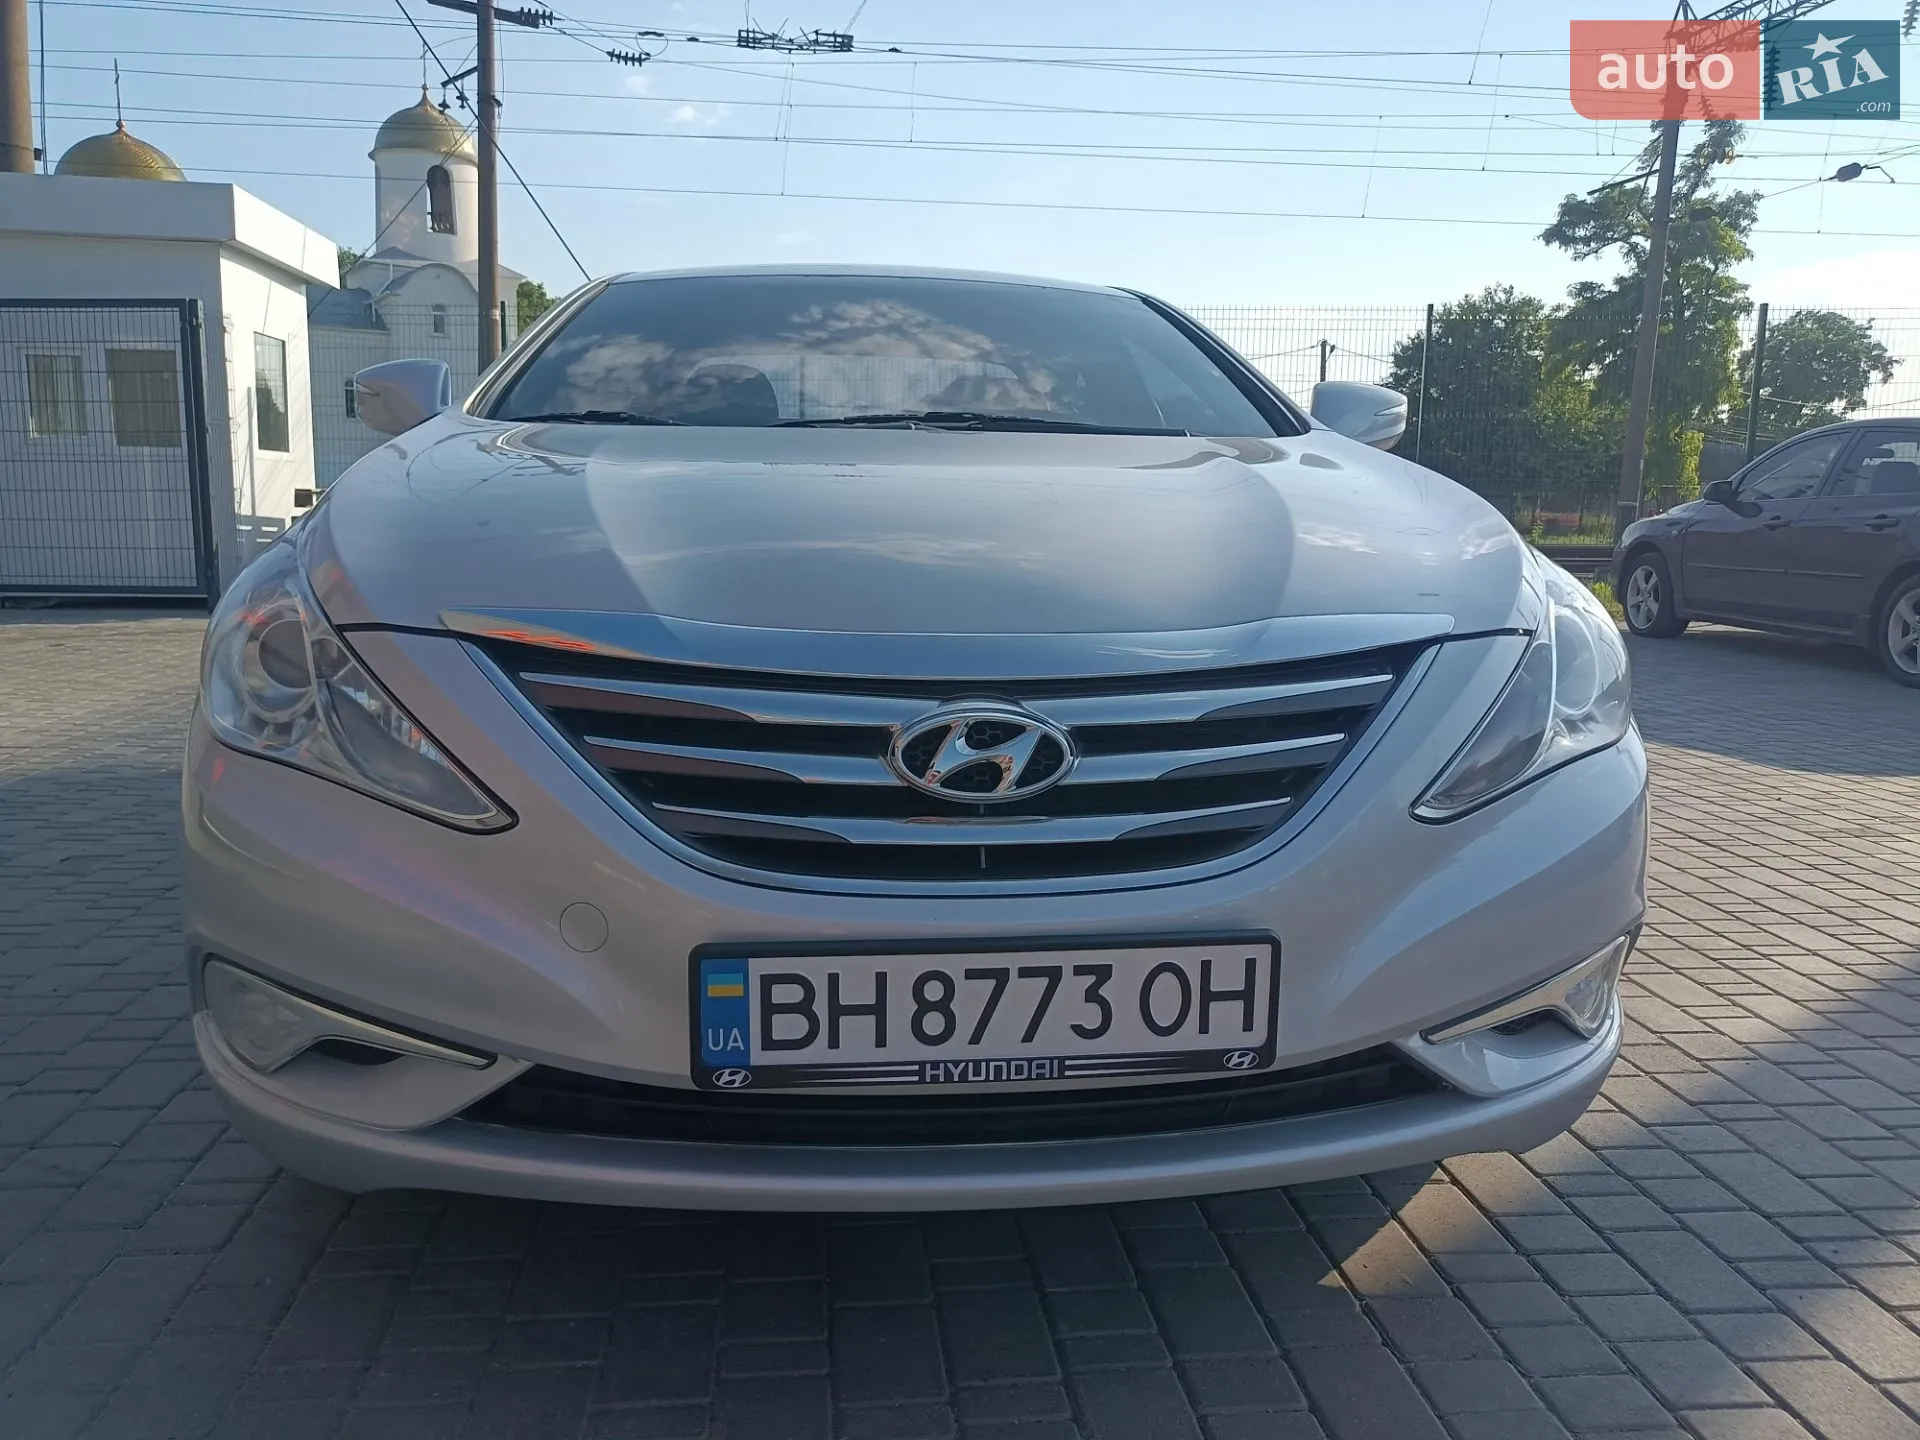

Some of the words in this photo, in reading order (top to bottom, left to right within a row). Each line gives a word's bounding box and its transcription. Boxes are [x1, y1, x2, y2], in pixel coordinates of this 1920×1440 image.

[759, 970, 888, 1052] BH
[910, 963, 1114, 1046] 8773
[1138, 957, 1258, 1037] OH
[707, 1028, 745, 1052] UA
[925, 1058, 1060, 1083] HYUNDAI
